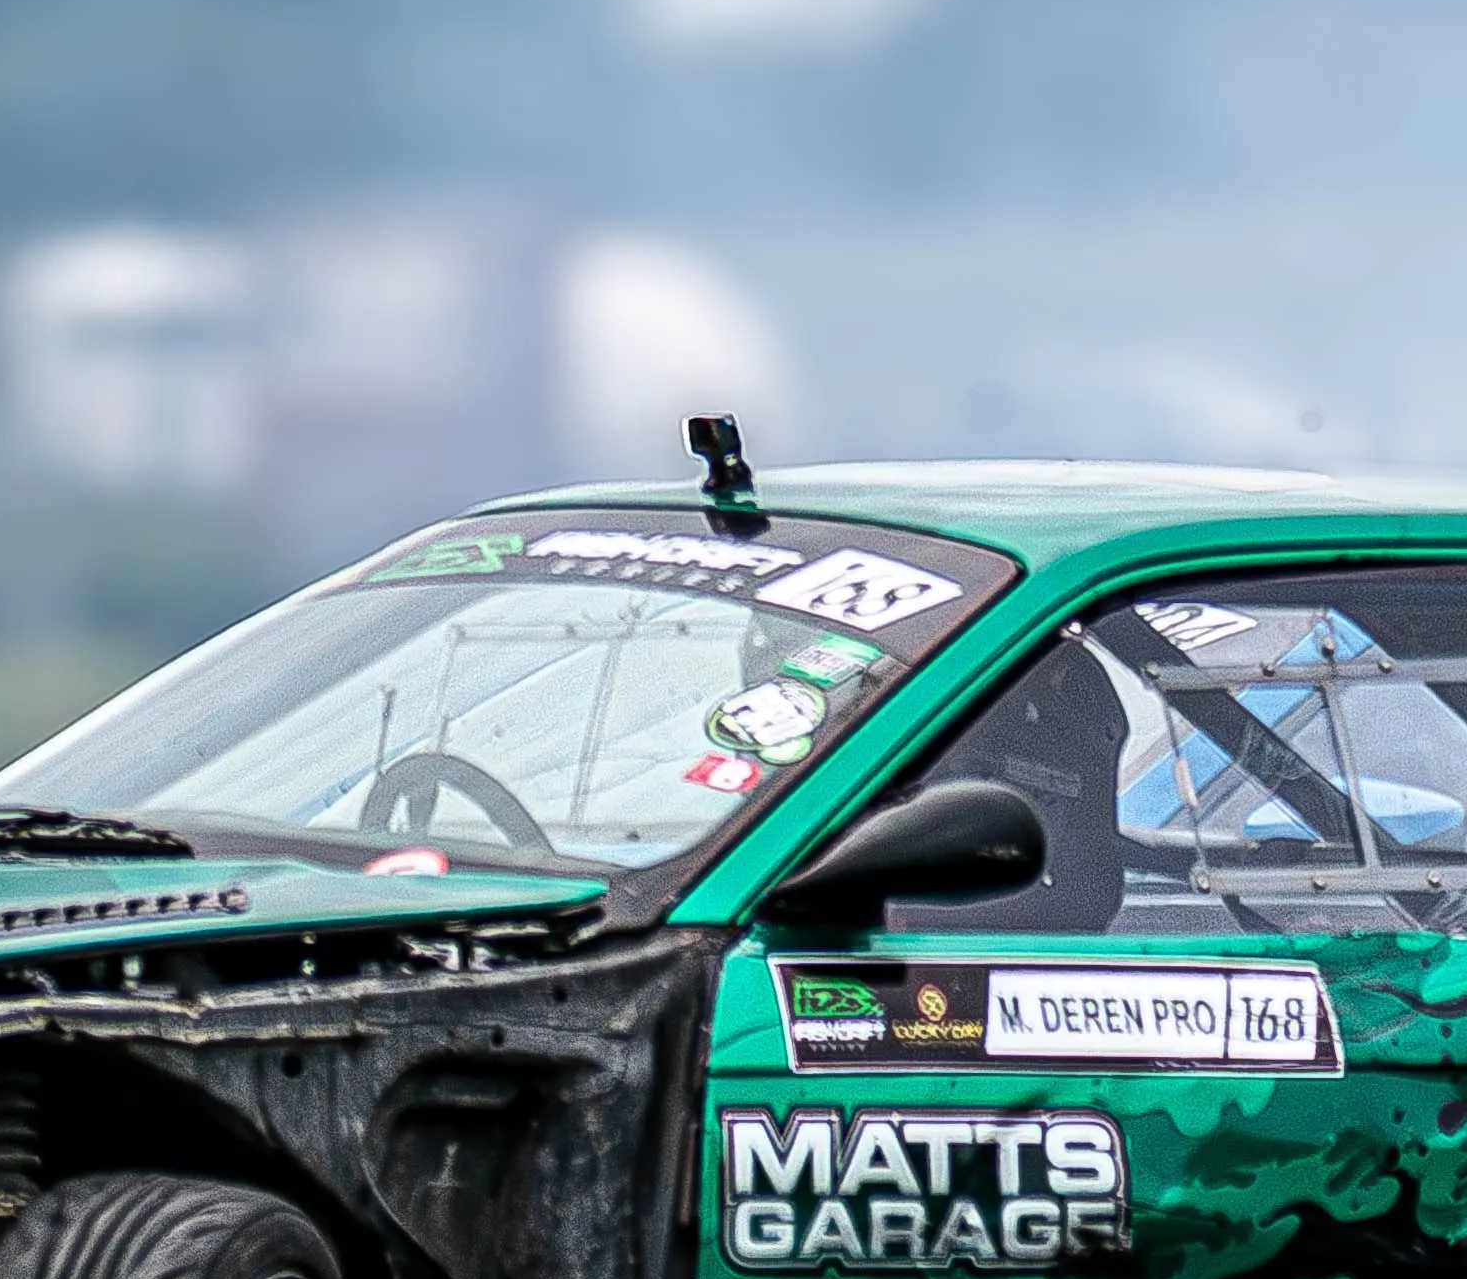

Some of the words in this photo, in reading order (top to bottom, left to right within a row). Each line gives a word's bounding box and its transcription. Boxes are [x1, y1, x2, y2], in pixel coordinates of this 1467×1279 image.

[996, 995, 1034, 1035] M.
[1039, 996, 1144, 1036] DEREN
[1151, 999, 1217, 1037] PRO
[1241, 996, 1307, 1043] 168
[731, 1121, 1117, 1197] MATTS
[734, 1200, 1117, 1260] GARAGE
